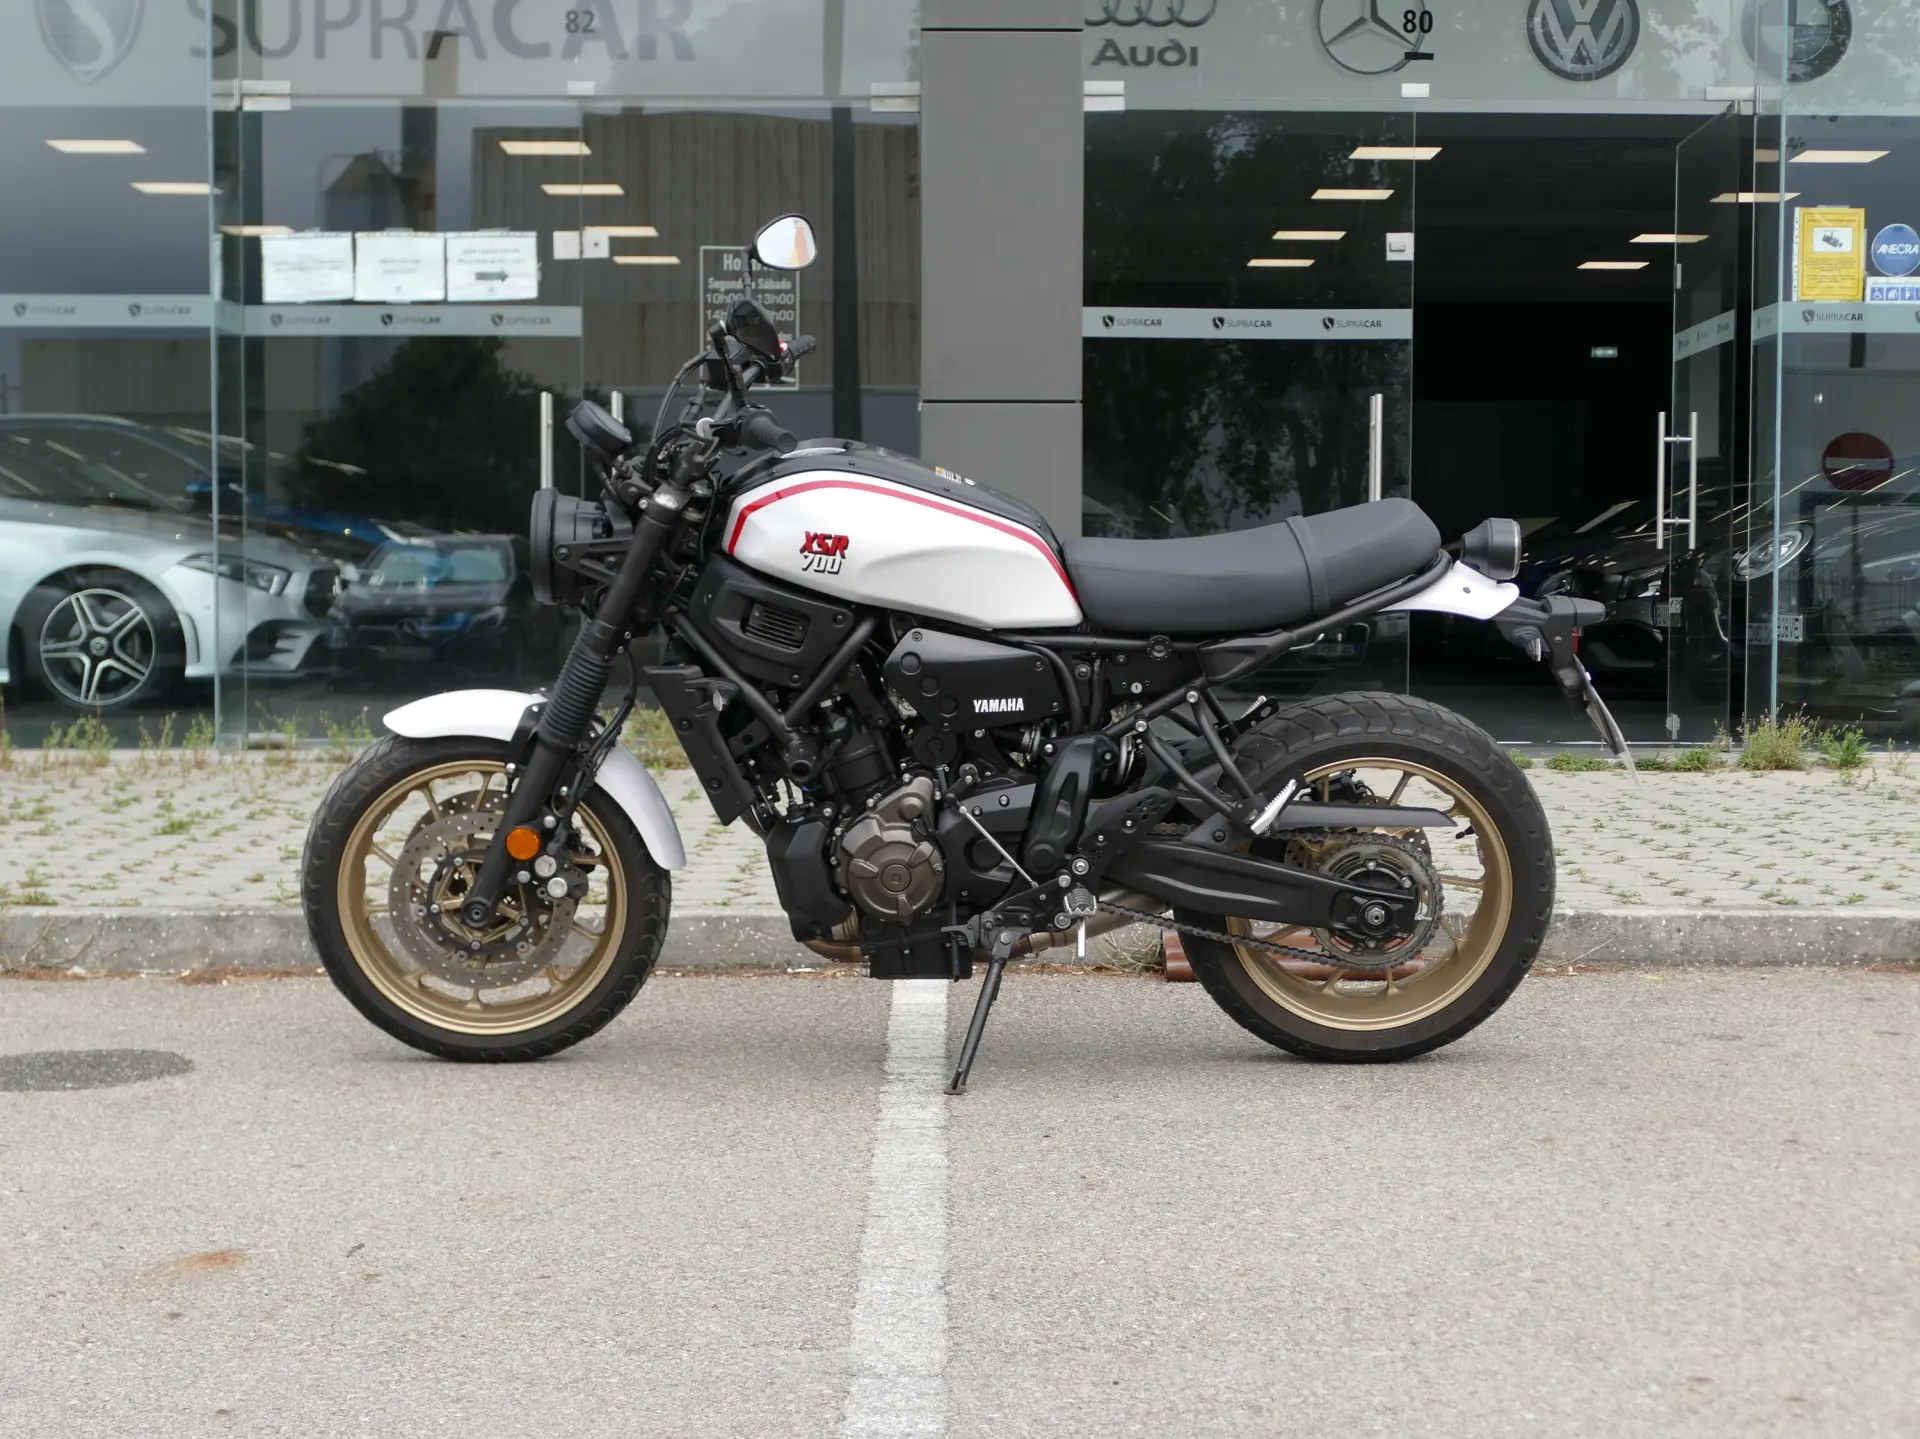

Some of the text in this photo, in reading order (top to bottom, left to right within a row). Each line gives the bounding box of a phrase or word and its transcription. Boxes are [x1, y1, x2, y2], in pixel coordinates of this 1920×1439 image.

[565, 10, 595, 34] 82
[1403, 9, 1433, 34] 80
[187, 0, 697, 61] SUPRACAR
[1091, 38, 1199, 67] Audi
[1876, 243, 1919, 255] ANECRA
[757, 292, 795, 305] 13h00
[1116, 317, 1163, 327] SUPRACAR
[1226, 319, 1273, 329] SUPRACAR
[1336, 319, 1383, 329] SUPRACAR
[1816, 312, 1864, 321] SUPRACAR
[799, 530, 850, 559] XSR
[801, 552, 843, 576] 700
[973, 697, 1025, 713] YAMAHA
